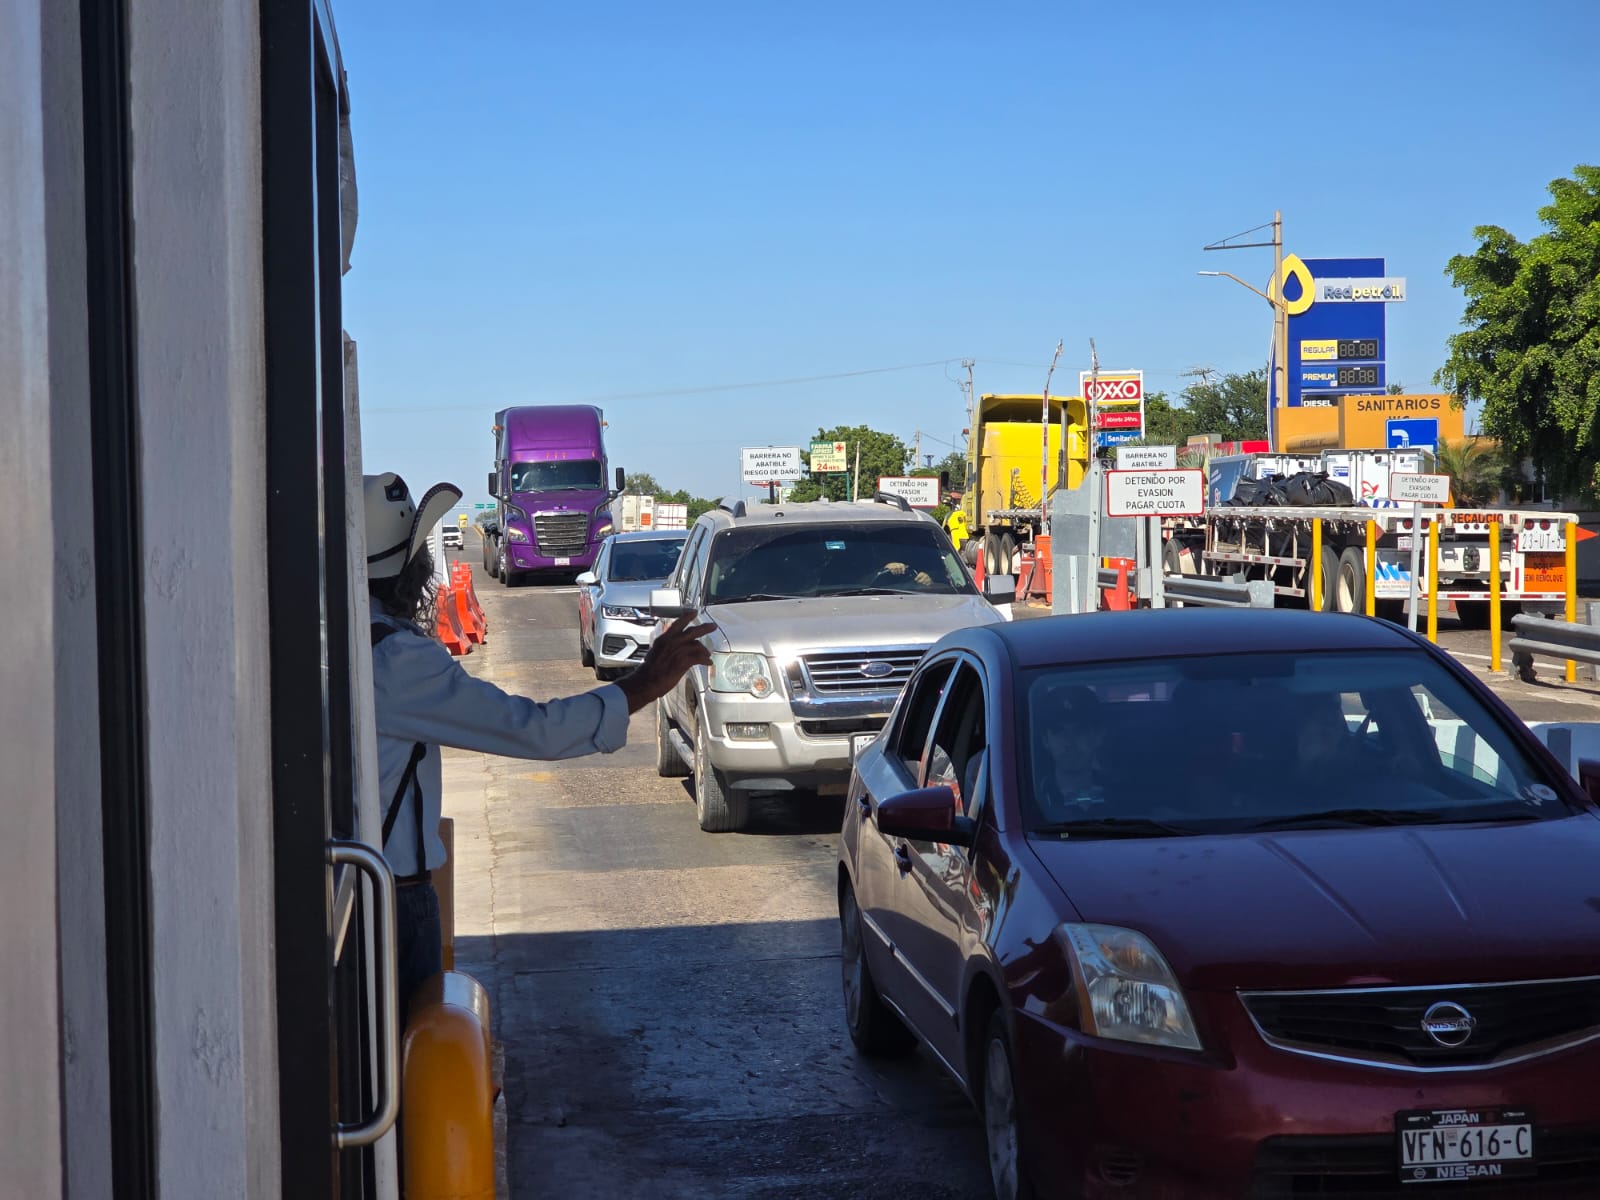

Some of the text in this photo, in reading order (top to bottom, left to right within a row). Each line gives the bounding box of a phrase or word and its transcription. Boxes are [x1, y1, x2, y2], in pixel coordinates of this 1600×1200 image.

[1303, 346, 1336, 354] REGULAR
[1302, 373, 1336, 381] PREMIUM
[1088, 381, 1138, 401] OXXO
[1357, 399, 1441, 411] SANITARIOS
[816, 463, 828, 471] 24
[1125, 476, 1186, 485] DETENIDO POR
[1138, 488, 1174, 498] EVASION
[1125, 500, 1186, 510] PAGAR CUOTA
[1427, 1019, 1473, 1030] NISSAN
[1438, 1113, 1480, 1125] JAPAN
[1404, 1126, 1529, 1161] VFN-616-C
[1436, 1164, 1502, 1178] NISSAN
